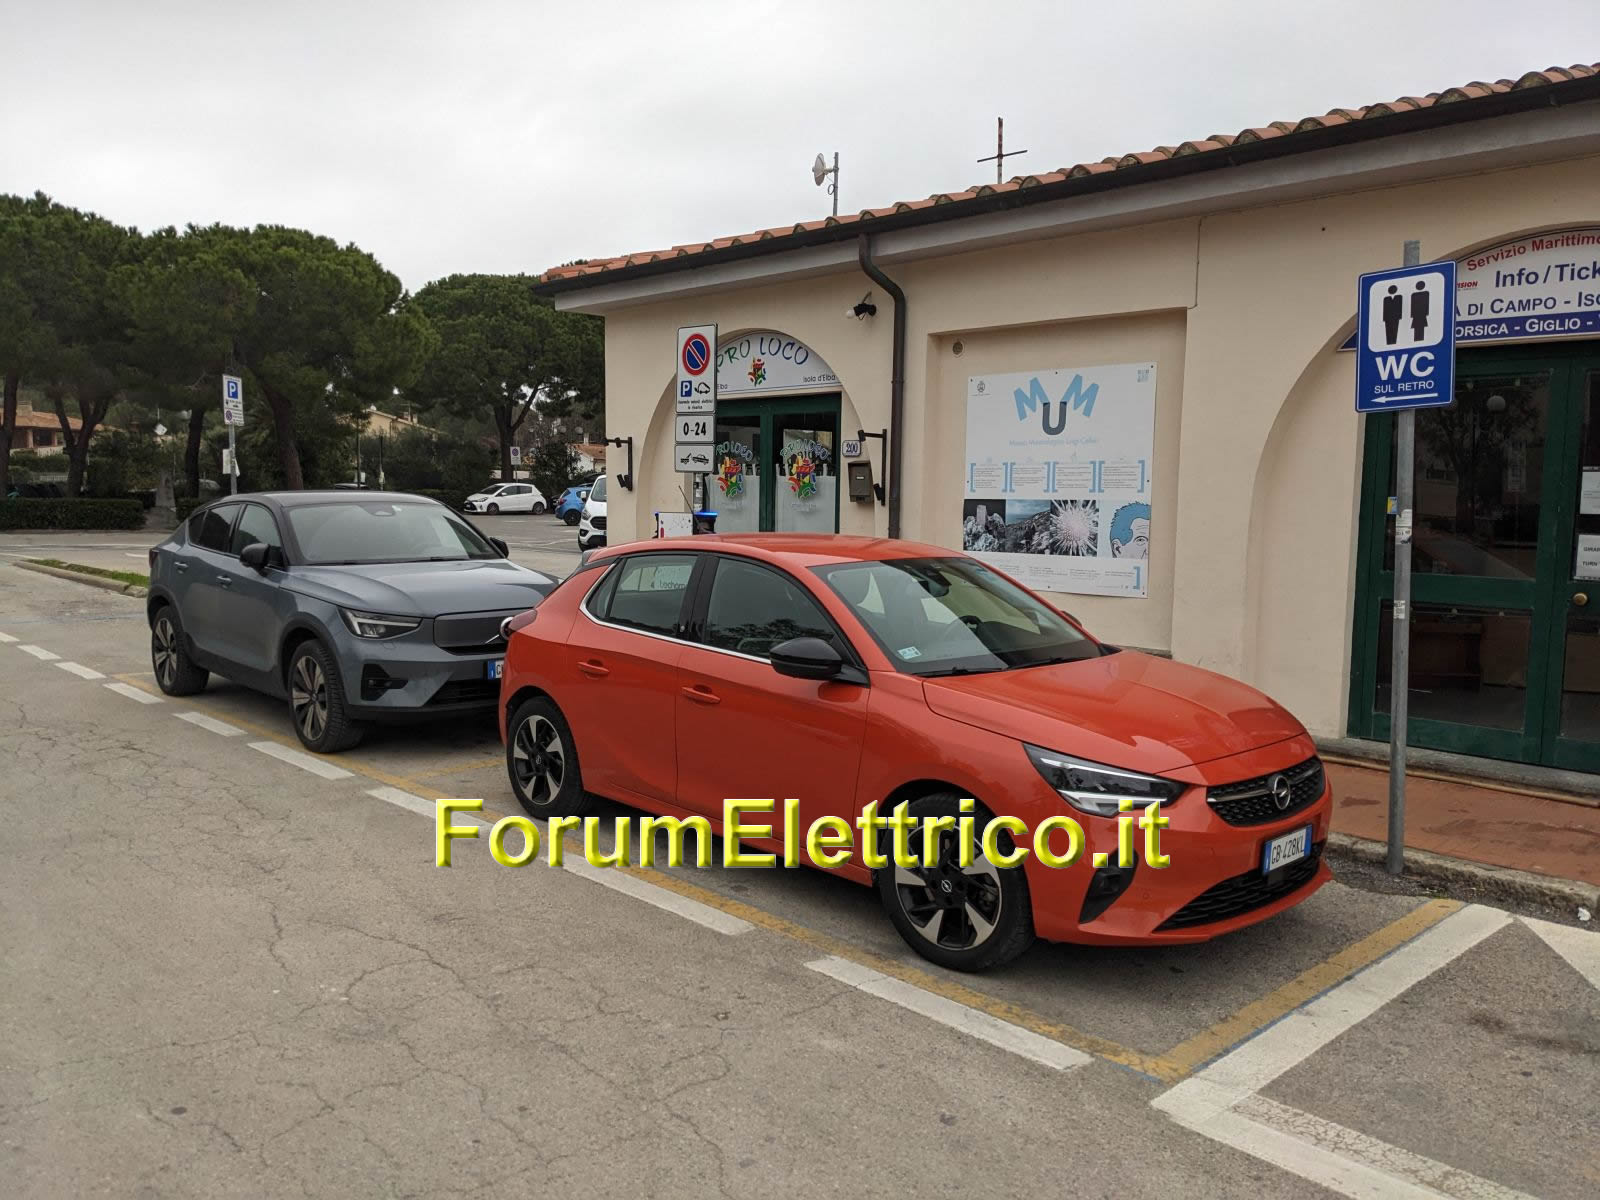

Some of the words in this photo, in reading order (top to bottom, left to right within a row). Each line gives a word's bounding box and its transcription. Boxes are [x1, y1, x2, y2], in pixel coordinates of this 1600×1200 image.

[1467, 245, 1526, 271] Servizio
[1490, 297, 1557, 314] CAMPO
[1456, 323, 1509, 338] ORSICA
[1525, 318, 1581, 333] GIGLIO
[760, 337, 808, 365] LOCO
[1375, 351, 1435, 381] WC
[1374, 384, 1394, 394] SUL
[1398, 380, 1434, 391] RETRO
[683, 422, 707, 436] 0-24
